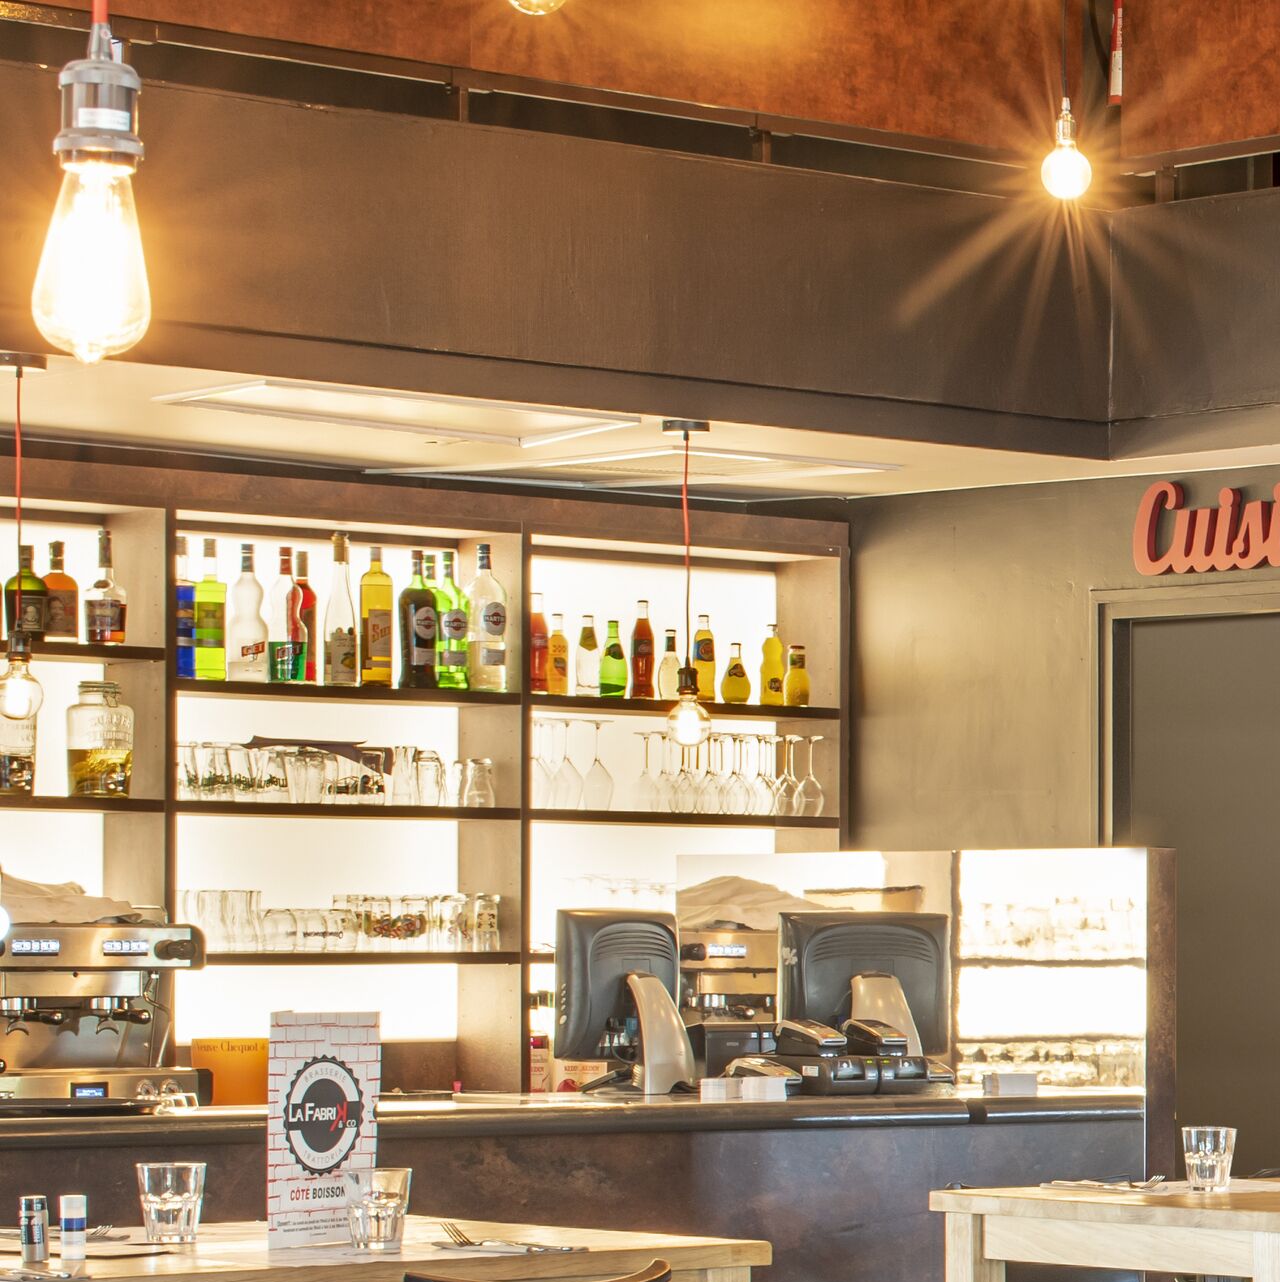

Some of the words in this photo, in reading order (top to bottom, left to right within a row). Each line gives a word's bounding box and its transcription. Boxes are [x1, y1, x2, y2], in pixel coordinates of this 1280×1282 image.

[288, 1102, 304, 1122] LA
[346, 1119, 357, 1128] CO
[290, 1184, 310, 1202] CÔTÉ
